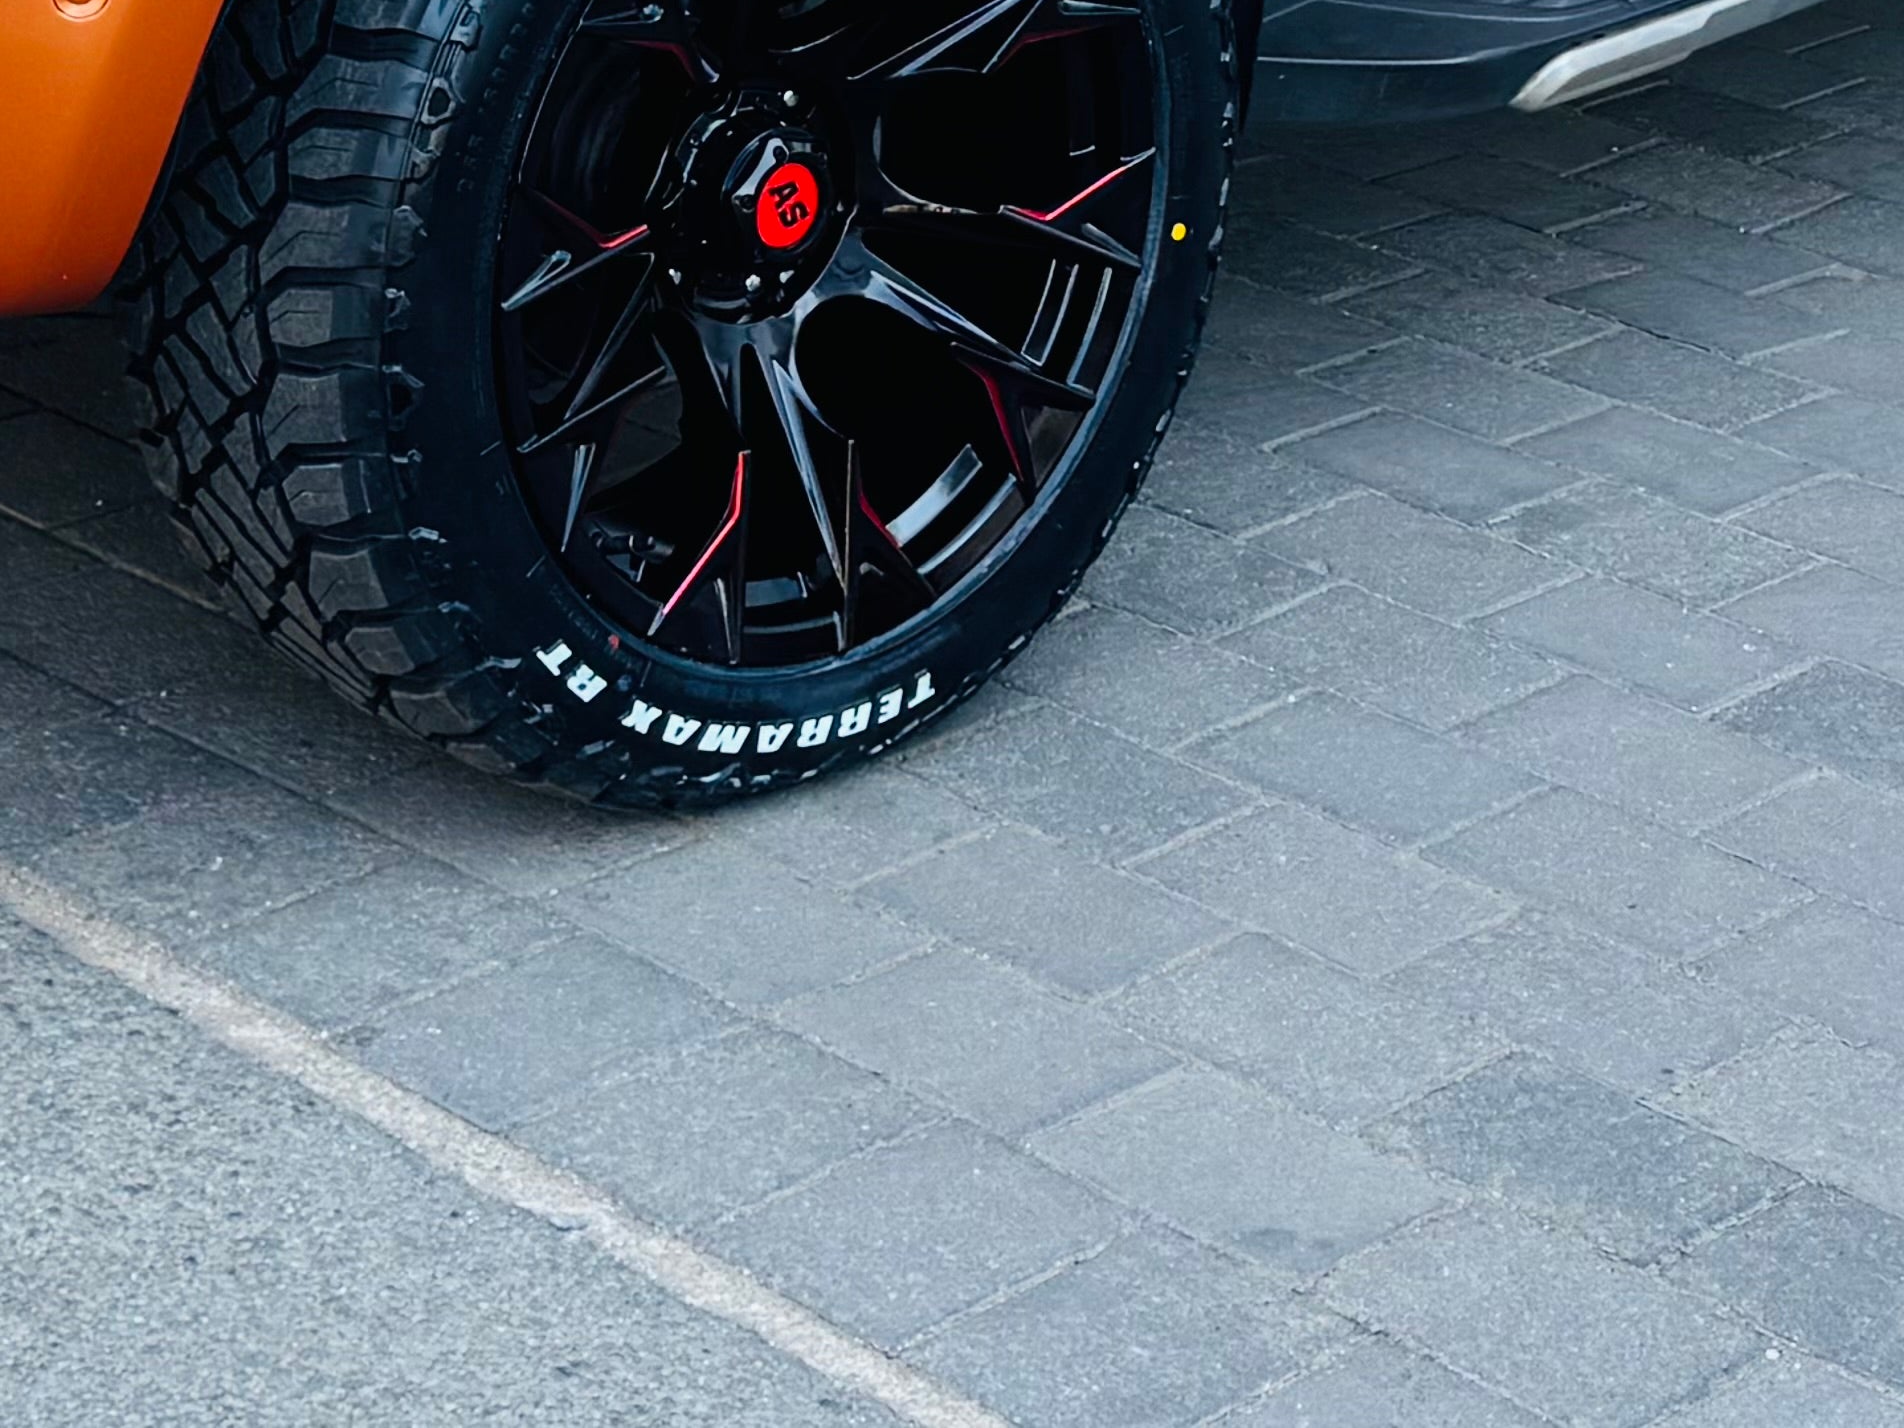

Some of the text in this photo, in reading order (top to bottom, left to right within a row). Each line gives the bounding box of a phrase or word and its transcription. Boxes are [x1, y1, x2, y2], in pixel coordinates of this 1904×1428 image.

[768, 180, 811, 229] AS
[535, 642, 937, 755] TERRAMAX RT
